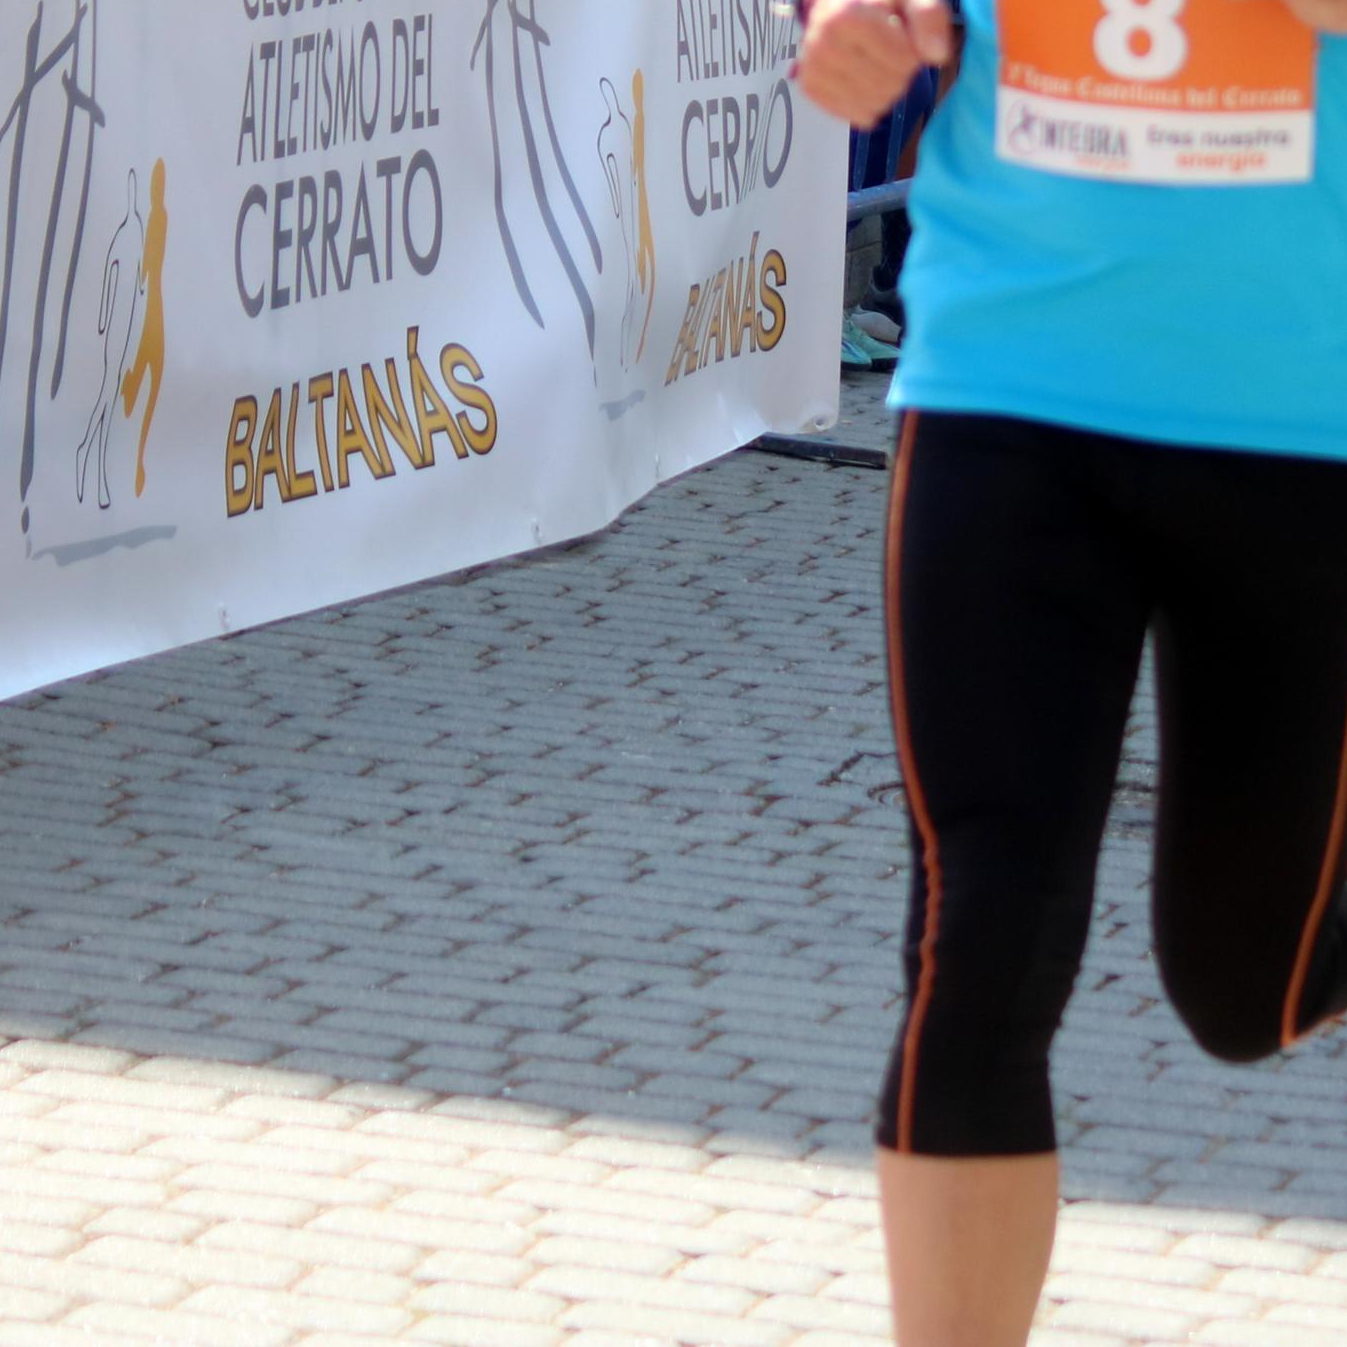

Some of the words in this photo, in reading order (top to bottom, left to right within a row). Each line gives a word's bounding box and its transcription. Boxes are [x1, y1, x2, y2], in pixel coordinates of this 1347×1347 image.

[237, 20, 380, 166] ATLETISMO
[390, 13, 440, 134] DEL
[234, 149, 443, 318] CERRATO
[225, 325, 497, 518] BALTANÁS
